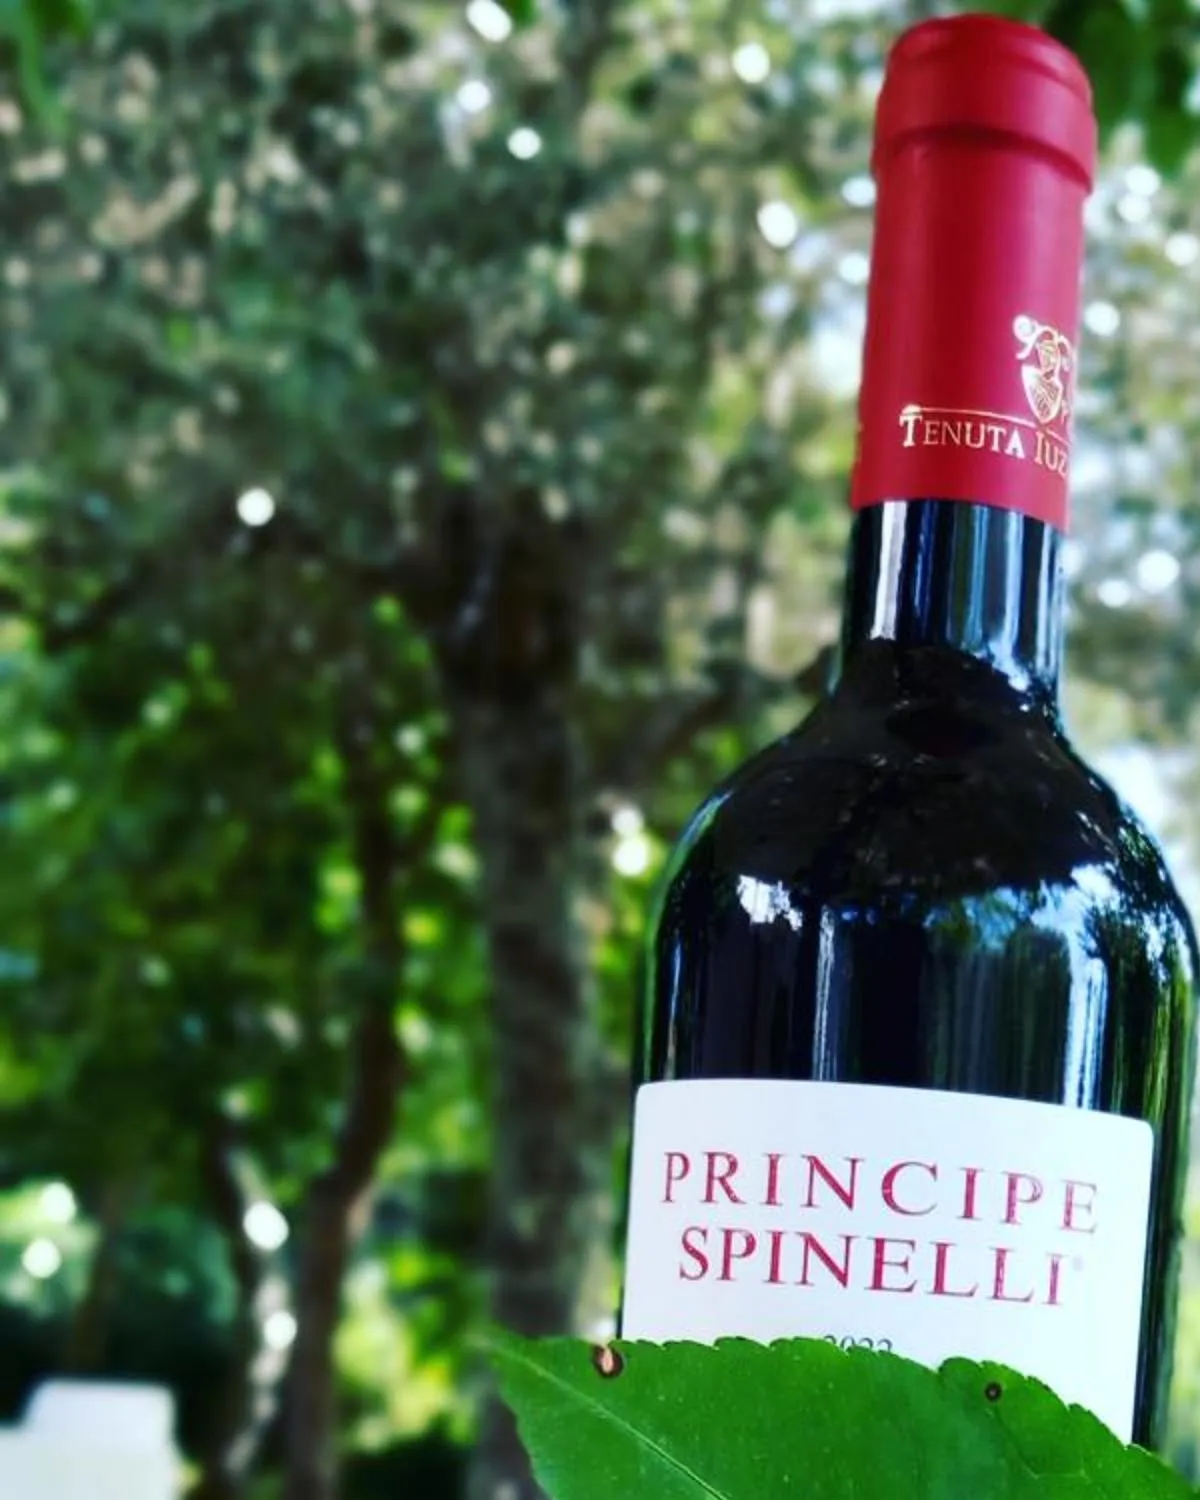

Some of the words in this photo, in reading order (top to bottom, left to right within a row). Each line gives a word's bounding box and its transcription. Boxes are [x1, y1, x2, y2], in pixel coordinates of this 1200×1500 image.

[900, 414, 1026, 459] TENUTA
[662, 1151, 1098, 1234] PRINCIPE
[679, 1226, 1065, 1305] SPINELLI
